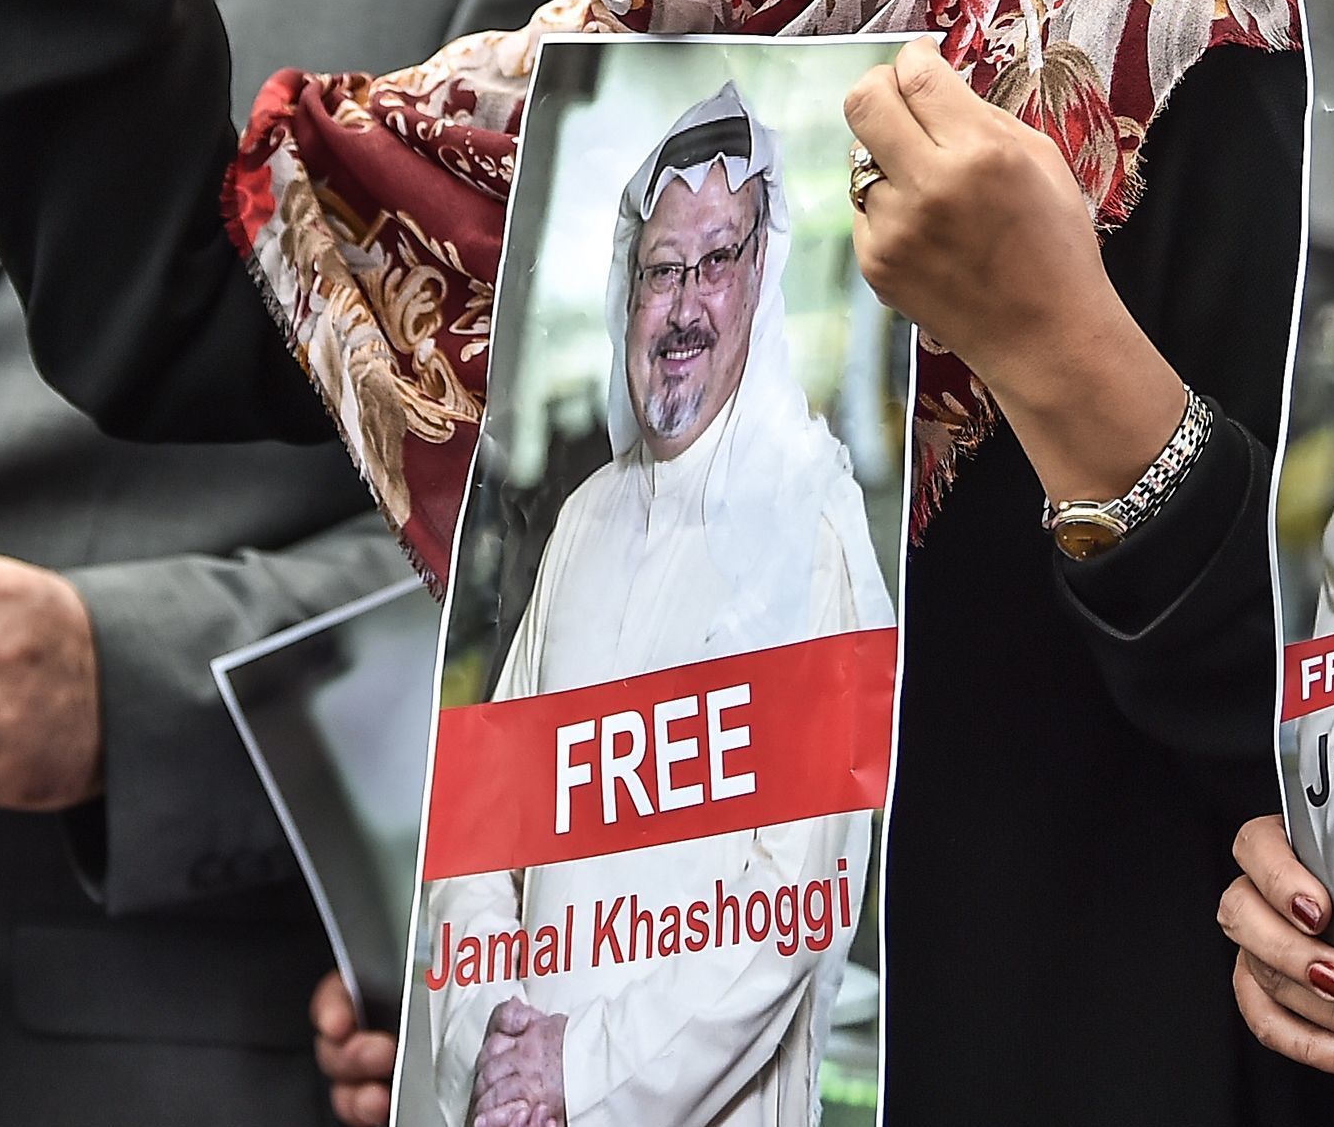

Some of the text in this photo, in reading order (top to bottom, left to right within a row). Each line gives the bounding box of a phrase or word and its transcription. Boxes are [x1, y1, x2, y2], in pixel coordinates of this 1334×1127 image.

[555, 683, 756, 834] FREE
[424, 858, 851, 991] Jamal Khashoggi
